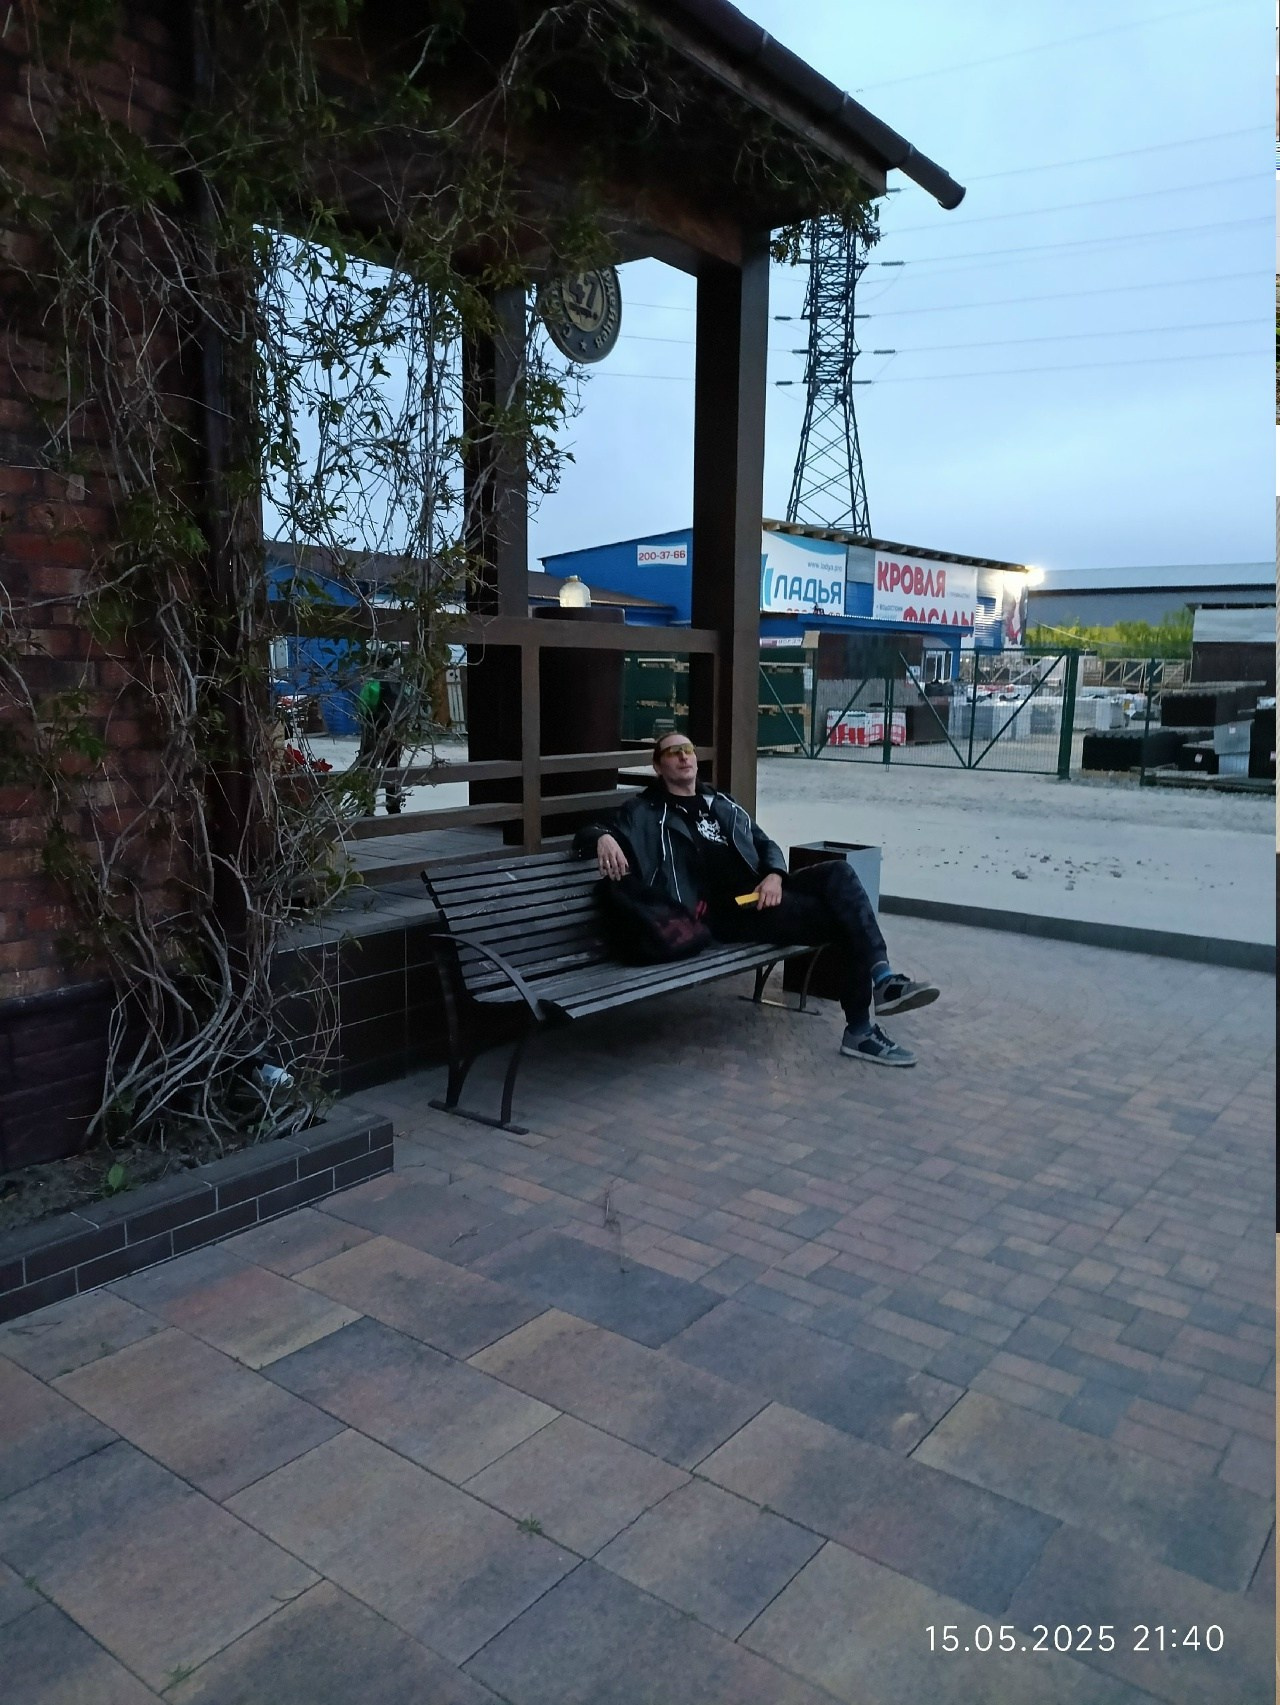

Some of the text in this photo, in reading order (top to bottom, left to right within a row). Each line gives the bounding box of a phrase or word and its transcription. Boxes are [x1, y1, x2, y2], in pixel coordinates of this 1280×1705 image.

[638, 550, 686, 561] 200-37-66
[773, 574, 842, 605] ЛАДЬЯ
[877, 560, 946, 598] КРОВЛЯ
